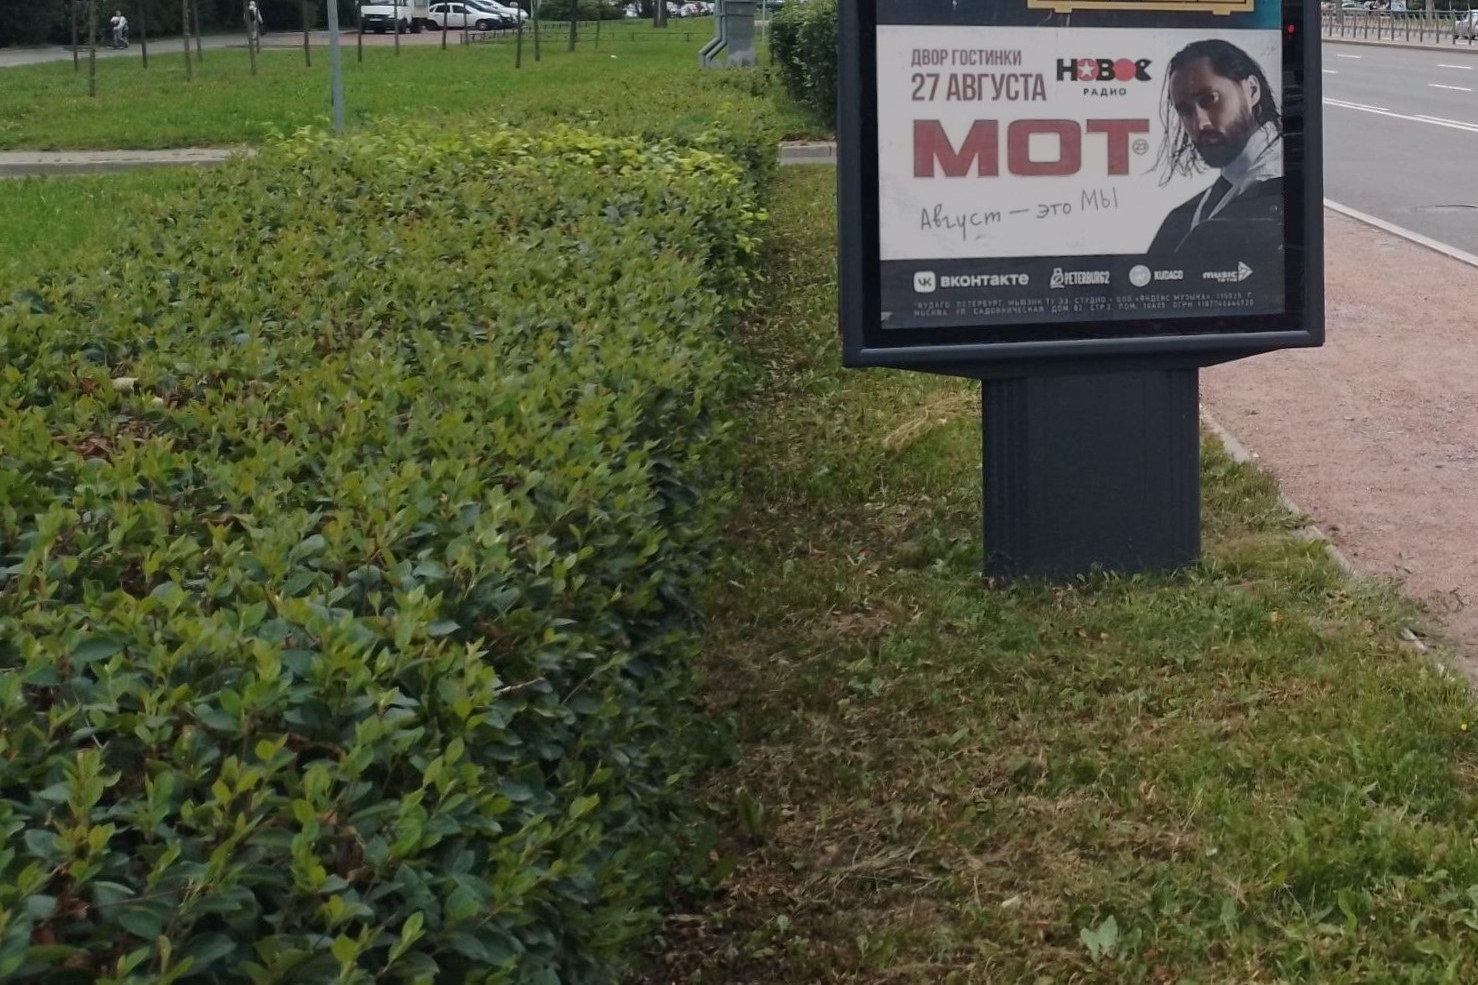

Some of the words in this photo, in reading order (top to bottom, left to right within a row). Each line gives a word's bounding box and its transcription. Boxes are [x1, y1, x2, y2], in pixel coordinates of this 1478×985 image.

[911, 49, 948, 67] ДВОР
[952, 49, 1022, 66] ГОСТИНКИ
[911, 73, 940, 101] 27
[946, 73, 1047, 101] АВГУСТА
[1083, 87, 1127, 97] РАДИО
[913, 118, 1150, 178] МОТ
[920, 204, 1001, 241] Август
[1036, 202, 1072, 219] это
[1081, 186, 1119, 211] МЫ
[1154, 270, 1184, 281] KUDAGO
